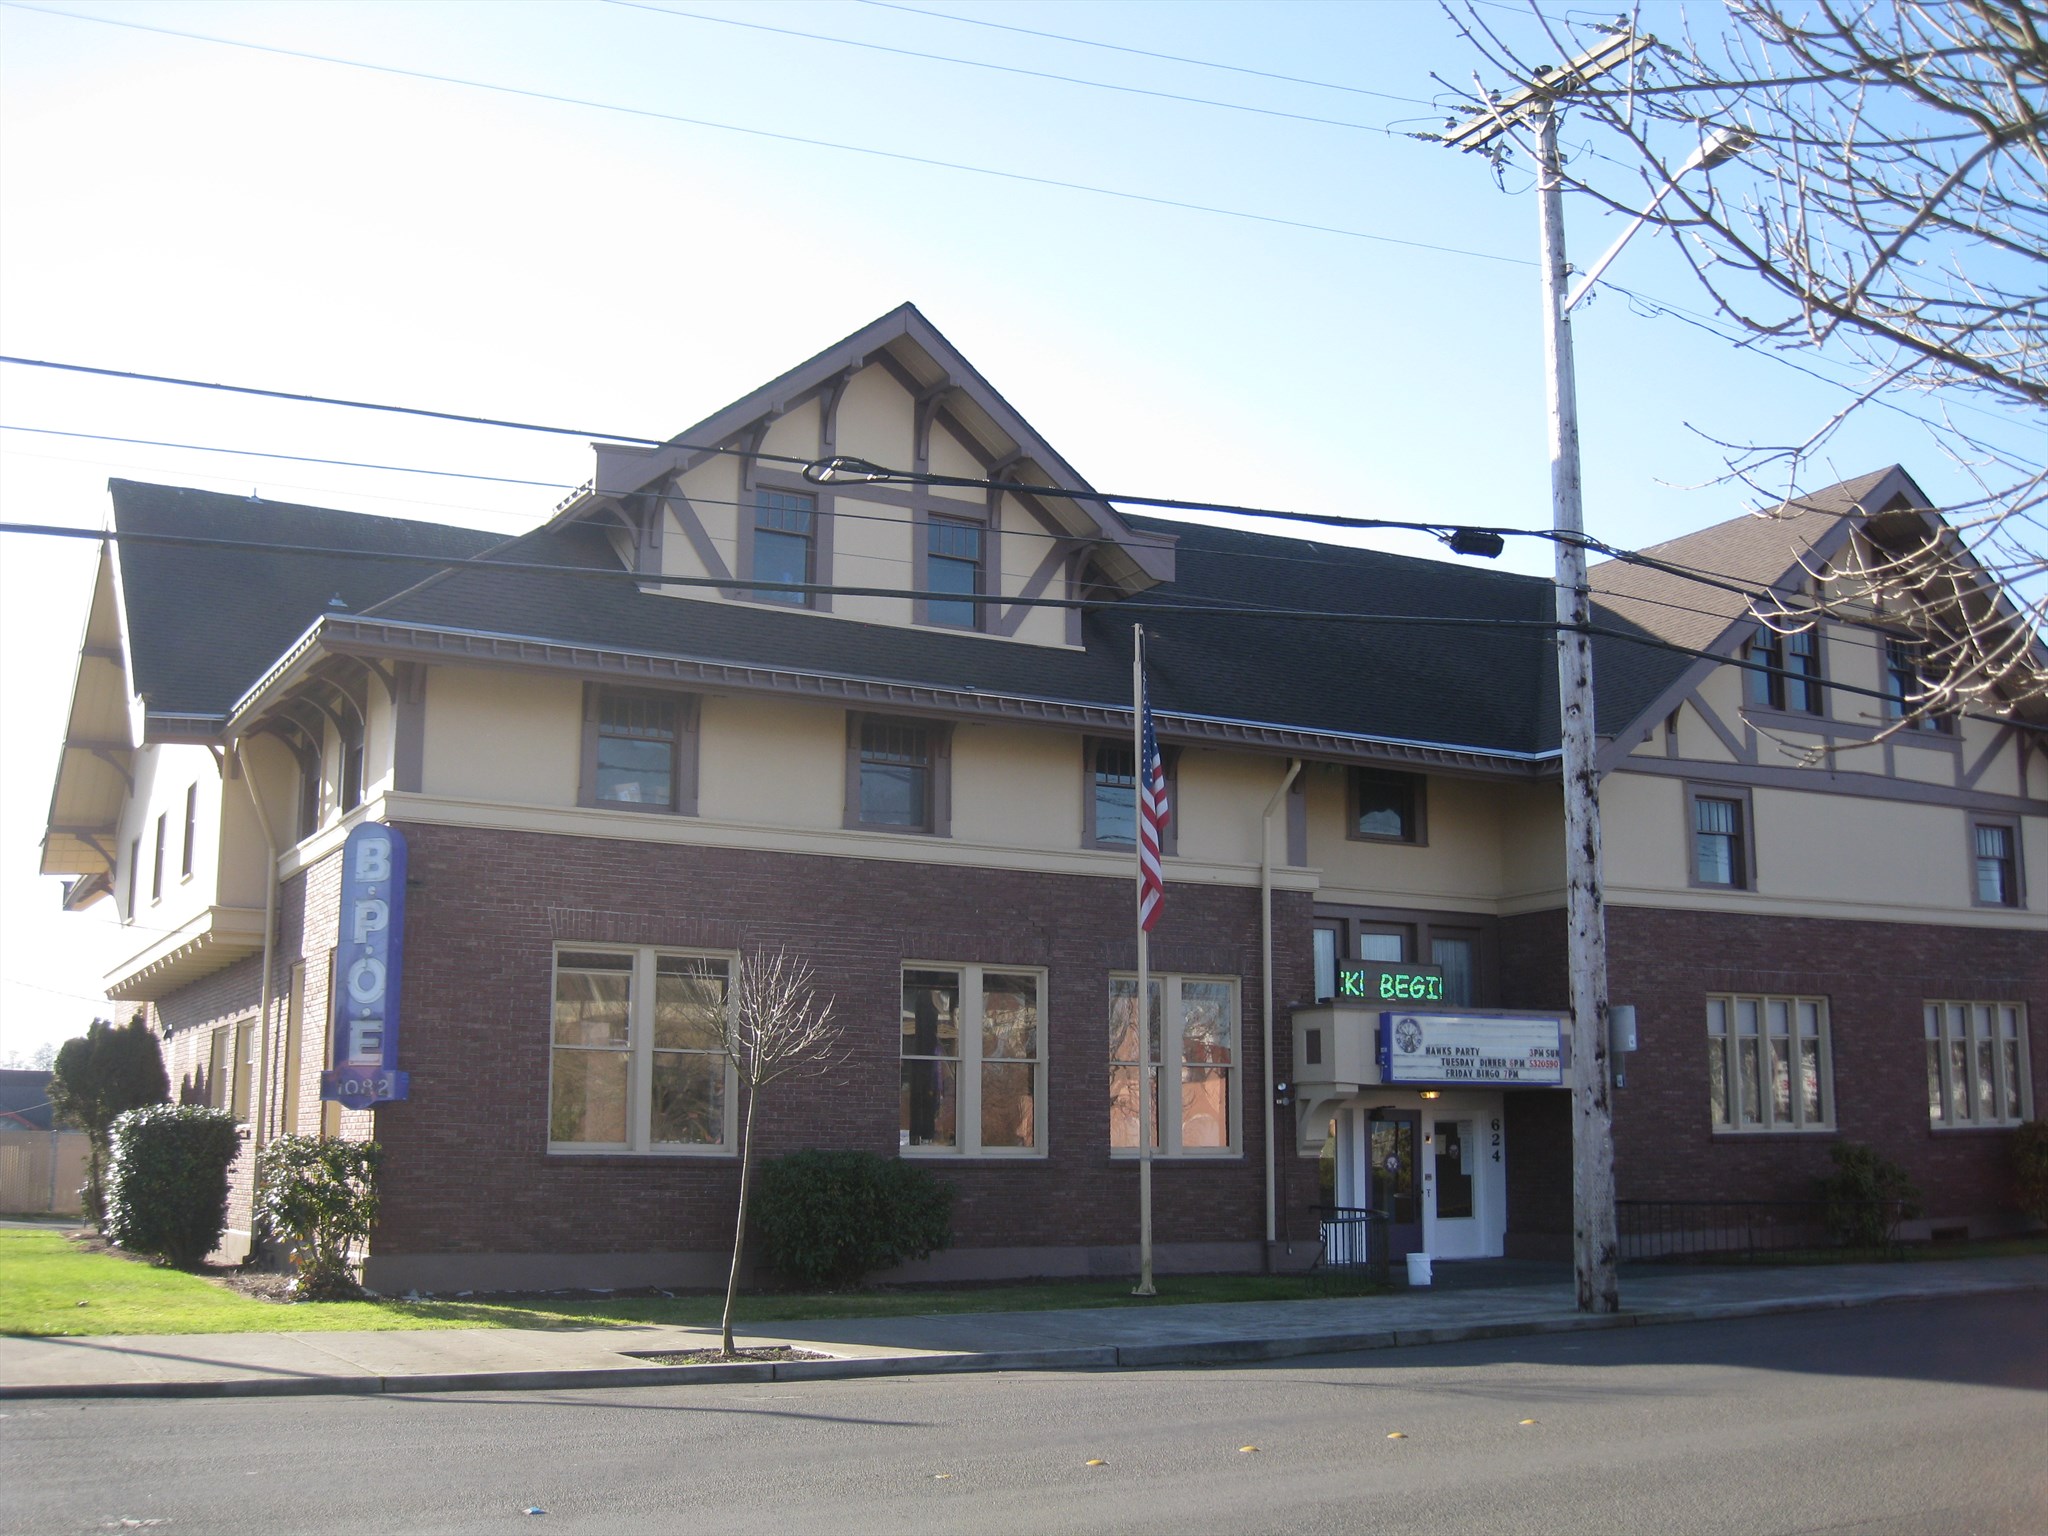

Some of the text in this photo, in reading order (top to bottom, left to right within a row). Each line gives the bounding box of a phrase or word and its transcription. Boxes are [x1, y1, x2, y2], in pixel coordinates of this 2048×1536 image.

[1425, 1046, 1452, 1056] HAWKS
[1455, 1047, 1480, 1056] PARTY
[1545, 1049, 1560, 1058] SUN
[1441, 1057, 1475, 1067] TUESDAY
[1480, 1058, 1507, 1068] DINNER
[1445, 1068, 1519, 1079] FRIDAY BINGO 7PM
[1491, 1118, 1501, 1163] 624
